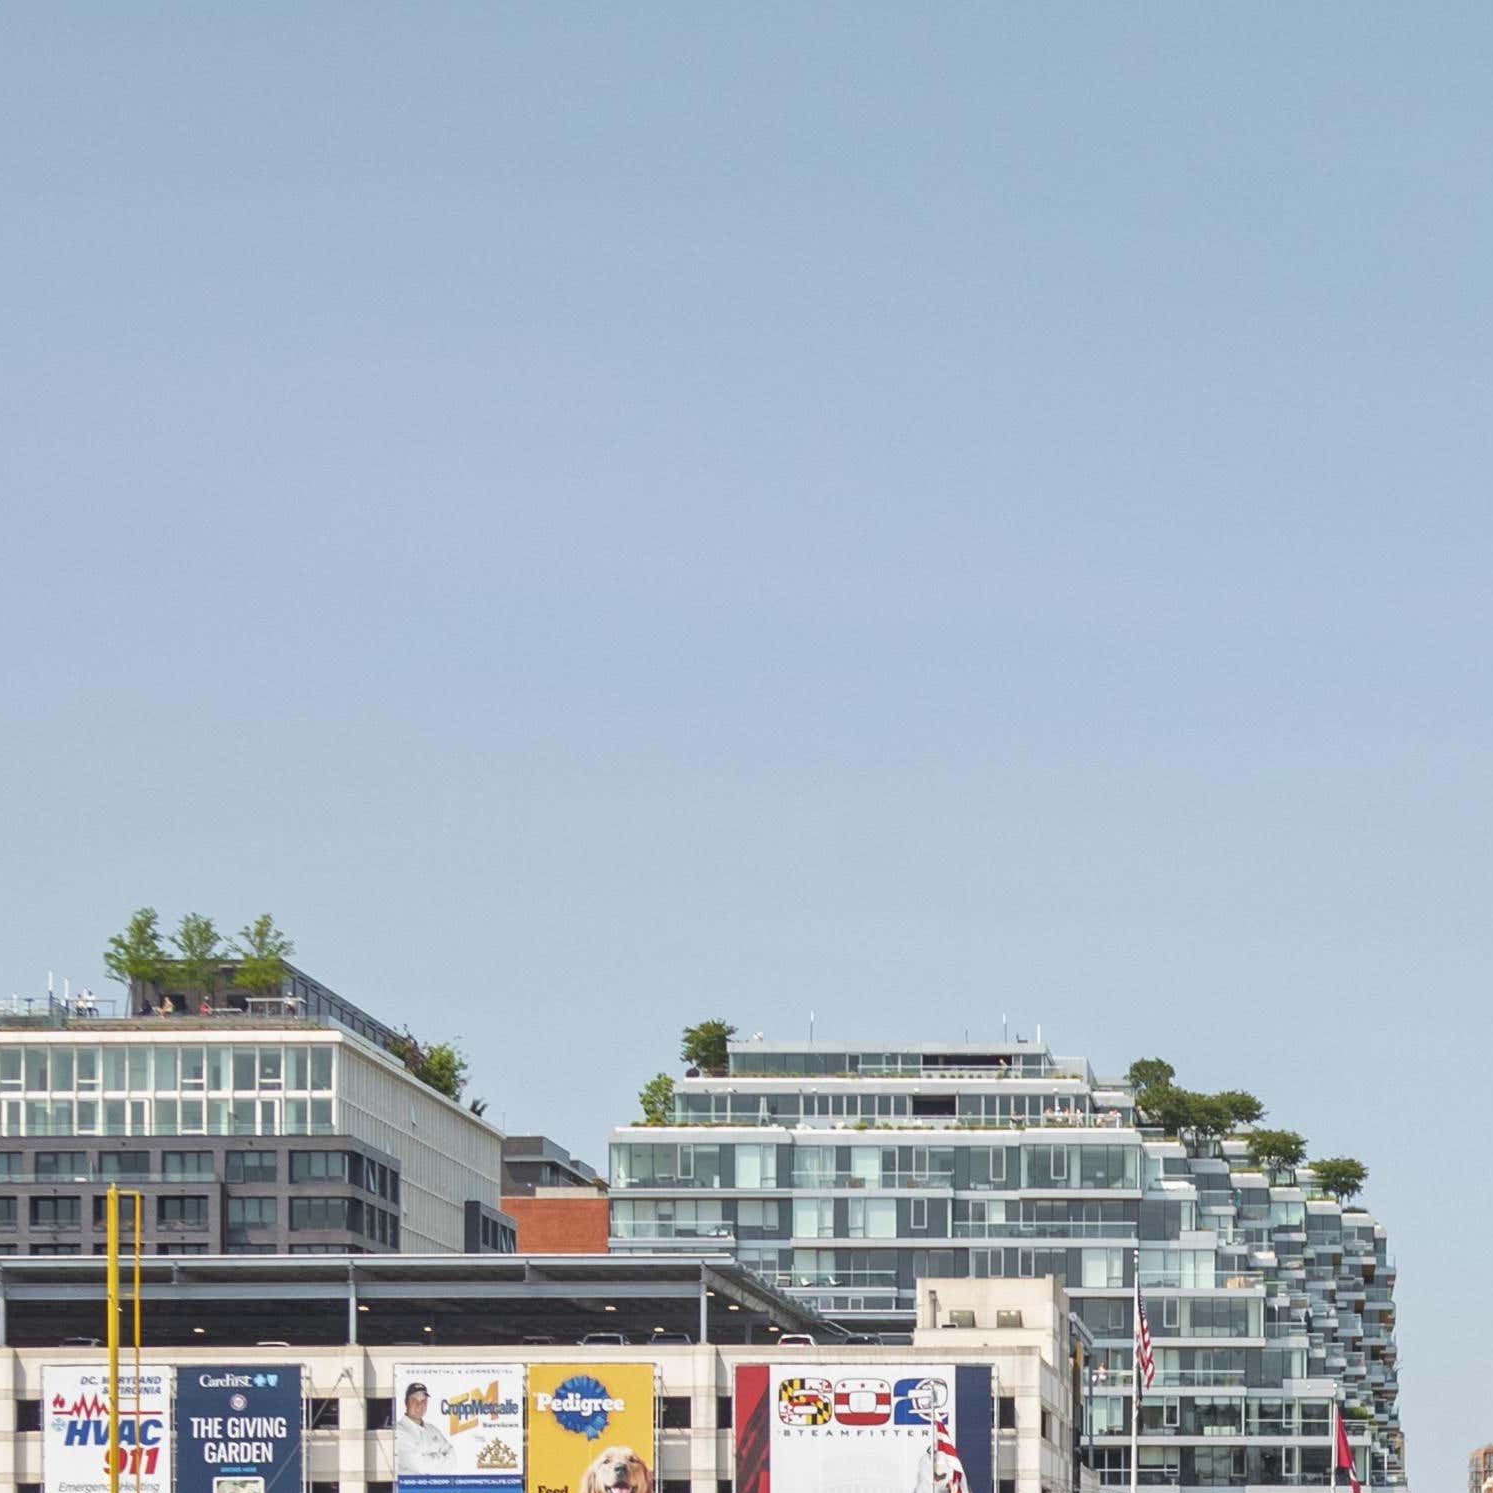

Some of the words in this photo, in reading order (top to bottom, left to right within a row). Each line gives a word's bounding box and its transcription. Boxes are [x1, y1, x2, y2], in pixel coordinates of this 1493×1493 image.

[199, 1374, 253, 1388] CareFirst
[536, 1392, 625, 1419] Pedigree
[778, 1377, 948, 1426] 602
[189, 1417, 224, 1439] THE
[227, 1416, 287, 1439] GIVING
[204, 1441, 274, 1464] GARDEN
